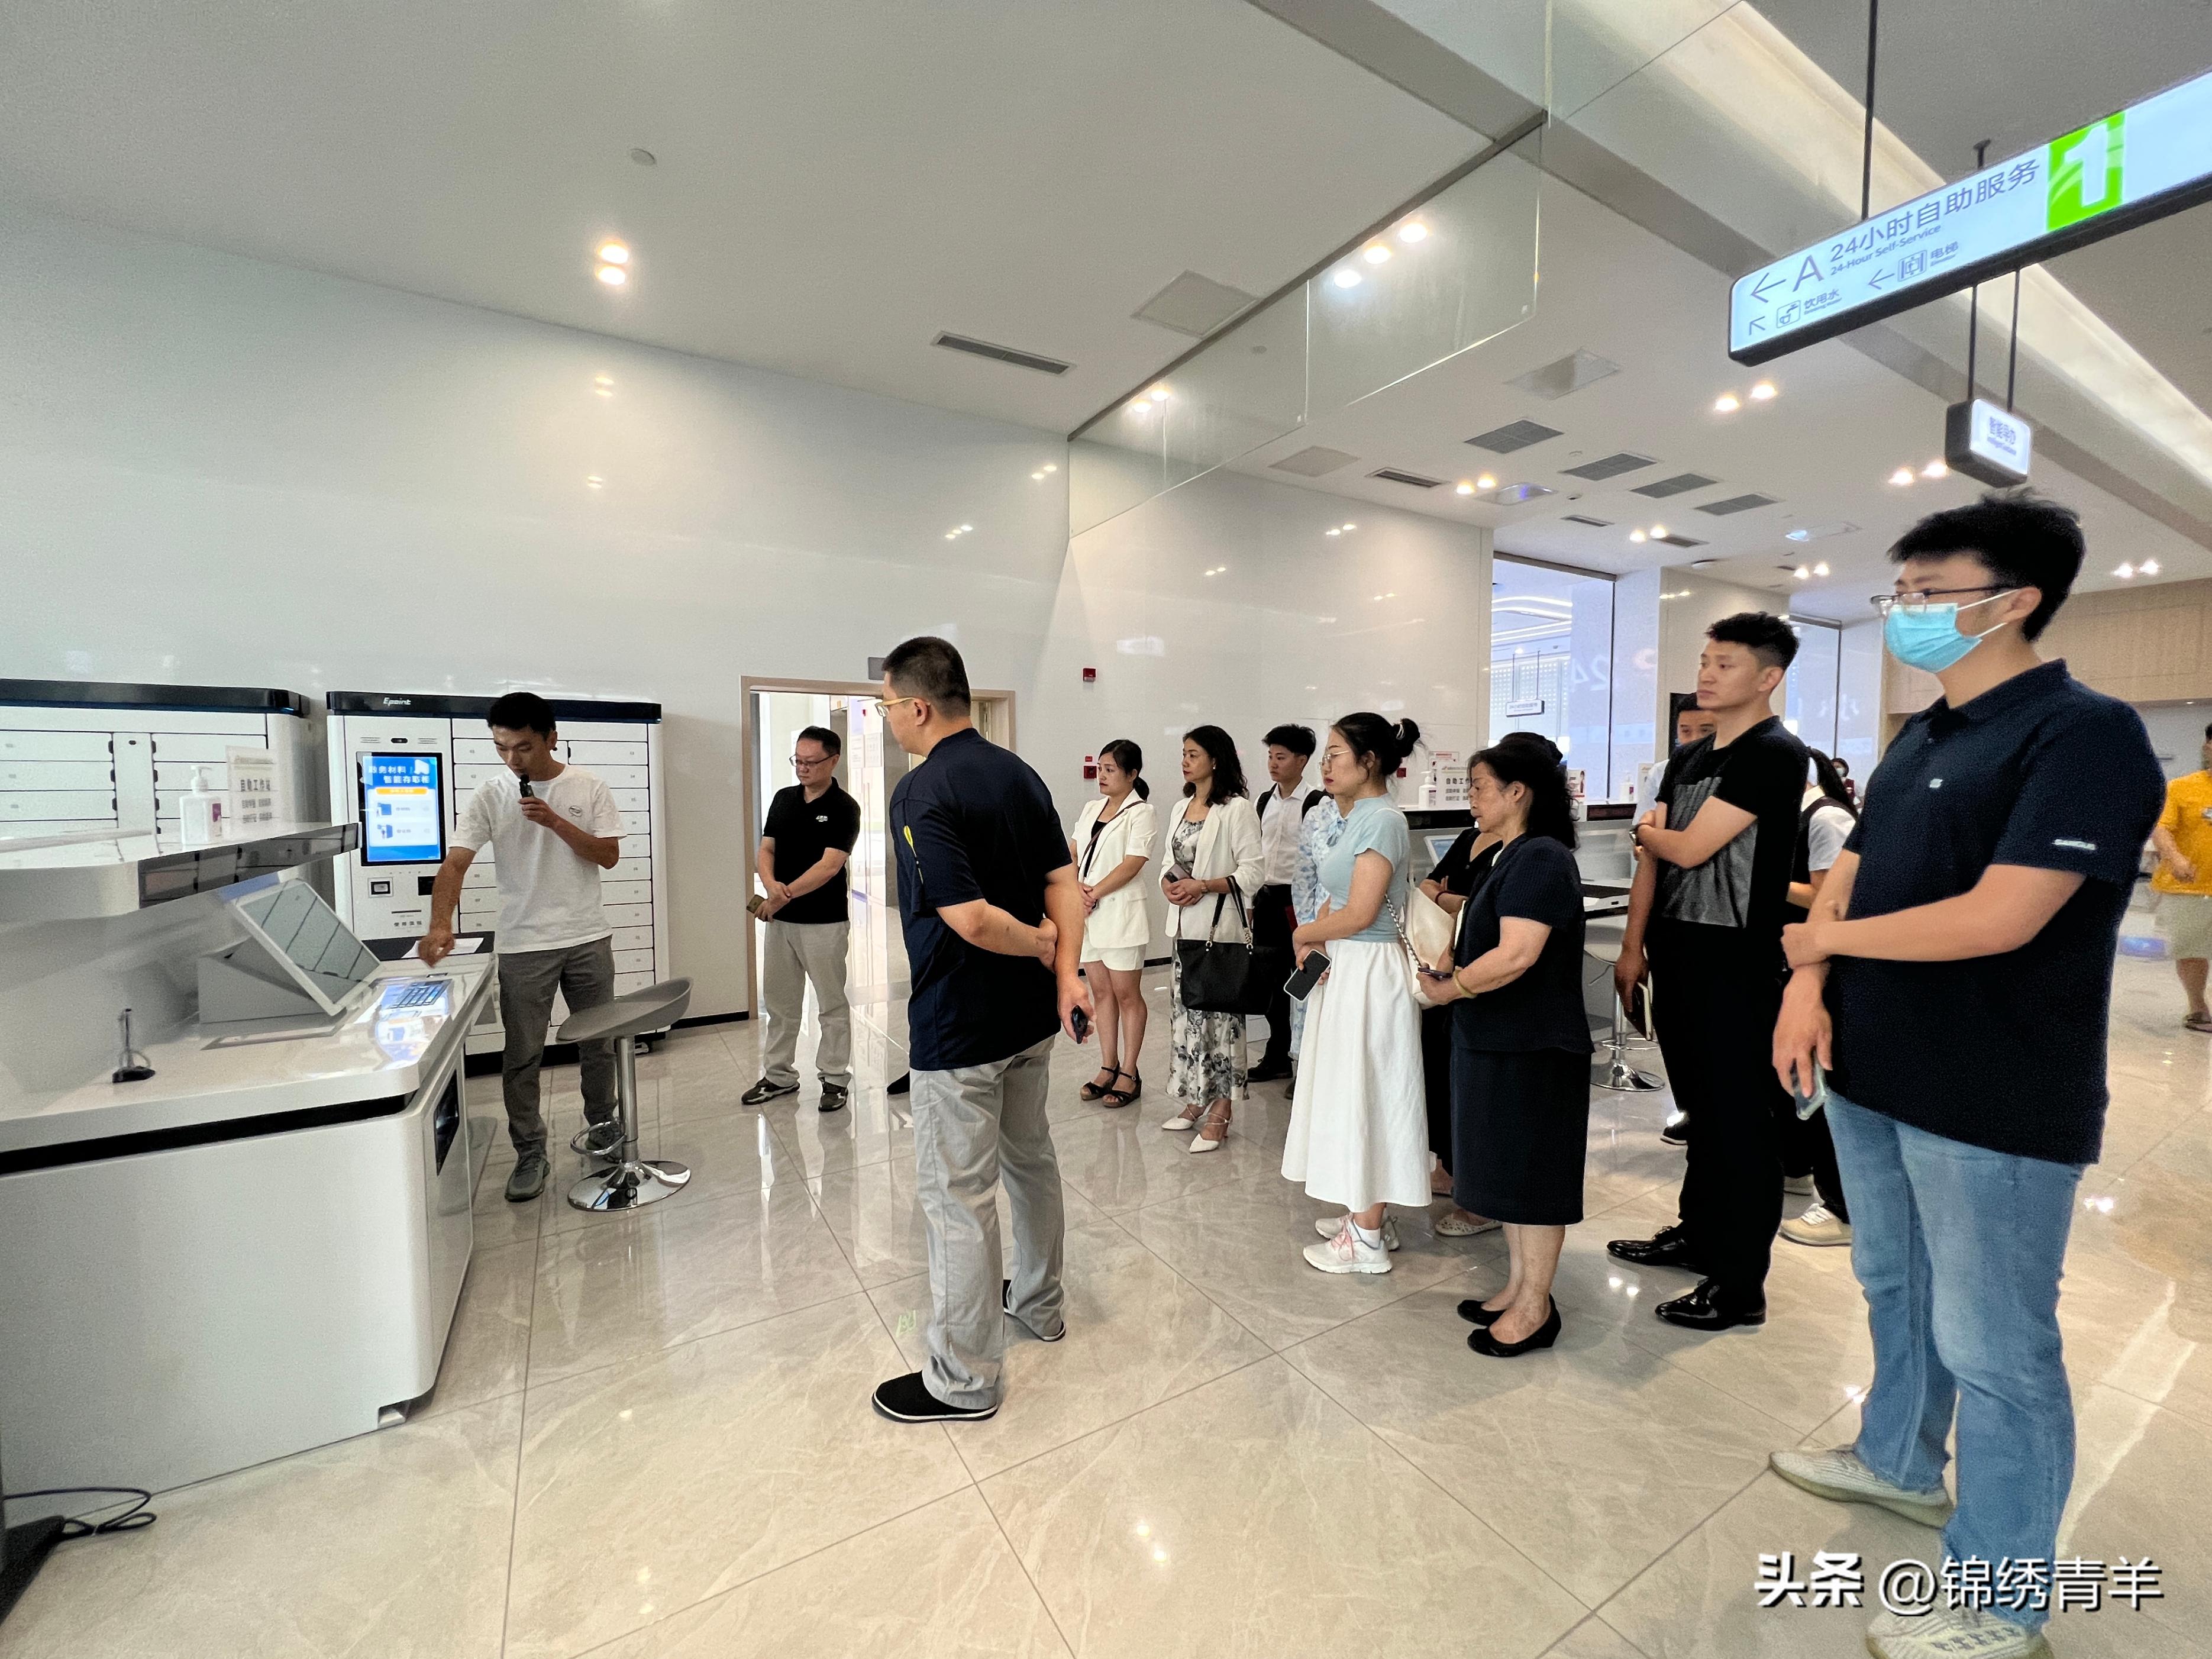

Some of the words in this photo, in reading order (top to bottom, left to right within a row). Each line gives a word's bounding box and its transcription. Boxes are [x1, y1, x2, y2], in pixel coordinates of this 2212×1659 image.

[2064, 122, 2108, 208] 1
[1830, 159, 2040, 262] 24小时自助服务
[1830, 253, 1873, 276] 24-Hour
[1875, 224, 1941, 257] Self-Service
[1930, 241, 1958, 259] 电梯
[1792, 255, 1825, 292] A
[1804, 289, 1839, 309] 饮用水
[383, 697, 411, 706] Epoint
